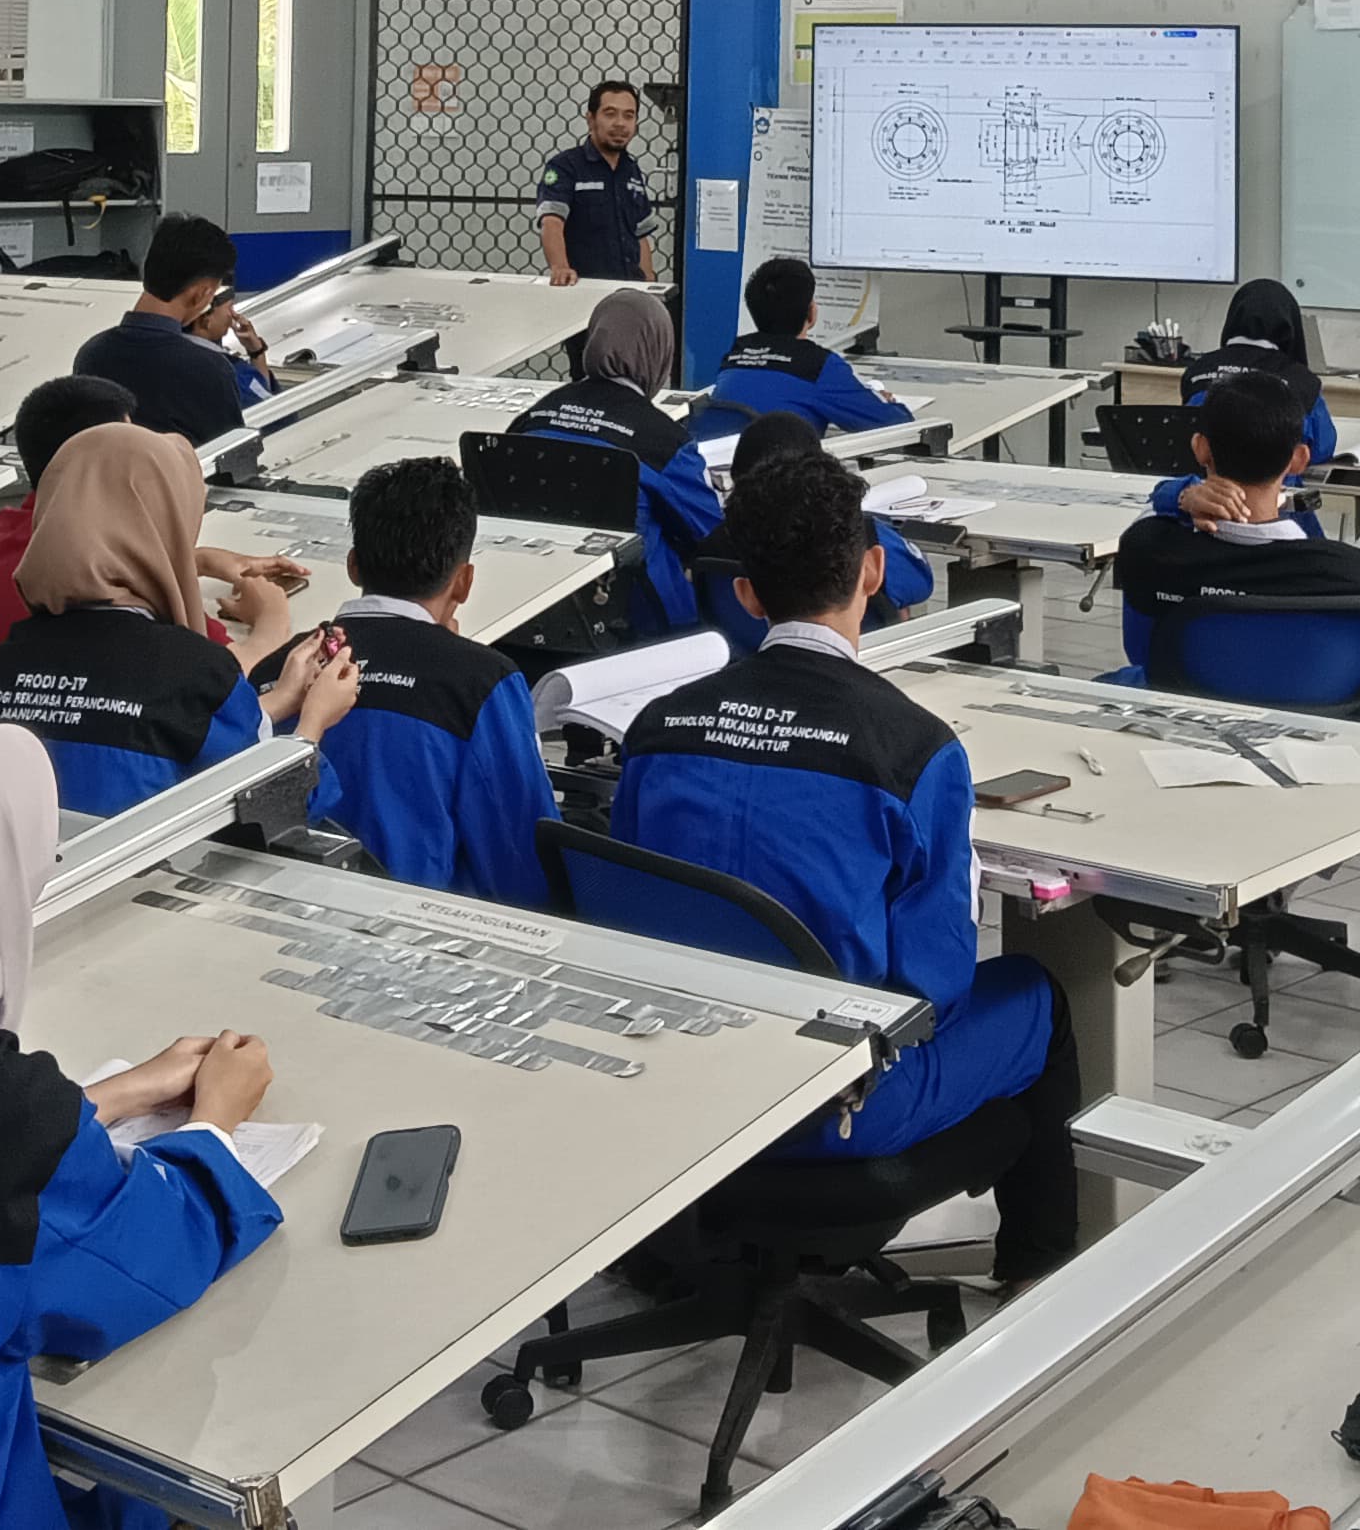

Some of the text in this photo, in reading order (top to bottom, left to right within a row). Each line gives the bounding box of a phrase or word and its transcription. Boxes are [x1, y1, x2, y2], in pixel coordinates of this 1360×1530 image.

[15, 673, 87, 691] PRODI D-IV
[0, 707, 82, 725] MANUFAKTUR
[13, 692, 61, 707] REKAYASA
[64, 695, 143, 718] PERANCANGAN
[718, 701, 797, 723] PRODI D-IV
[664, 716, 849, 746] TEKNOLOGI REKAYASA PERANCANGAN
[704, 730, 790, 752] MANUFAKTUR
[417, 901, 473, 920] SETELAH
[471, 913, 553, 938] DIGUNAKAN
